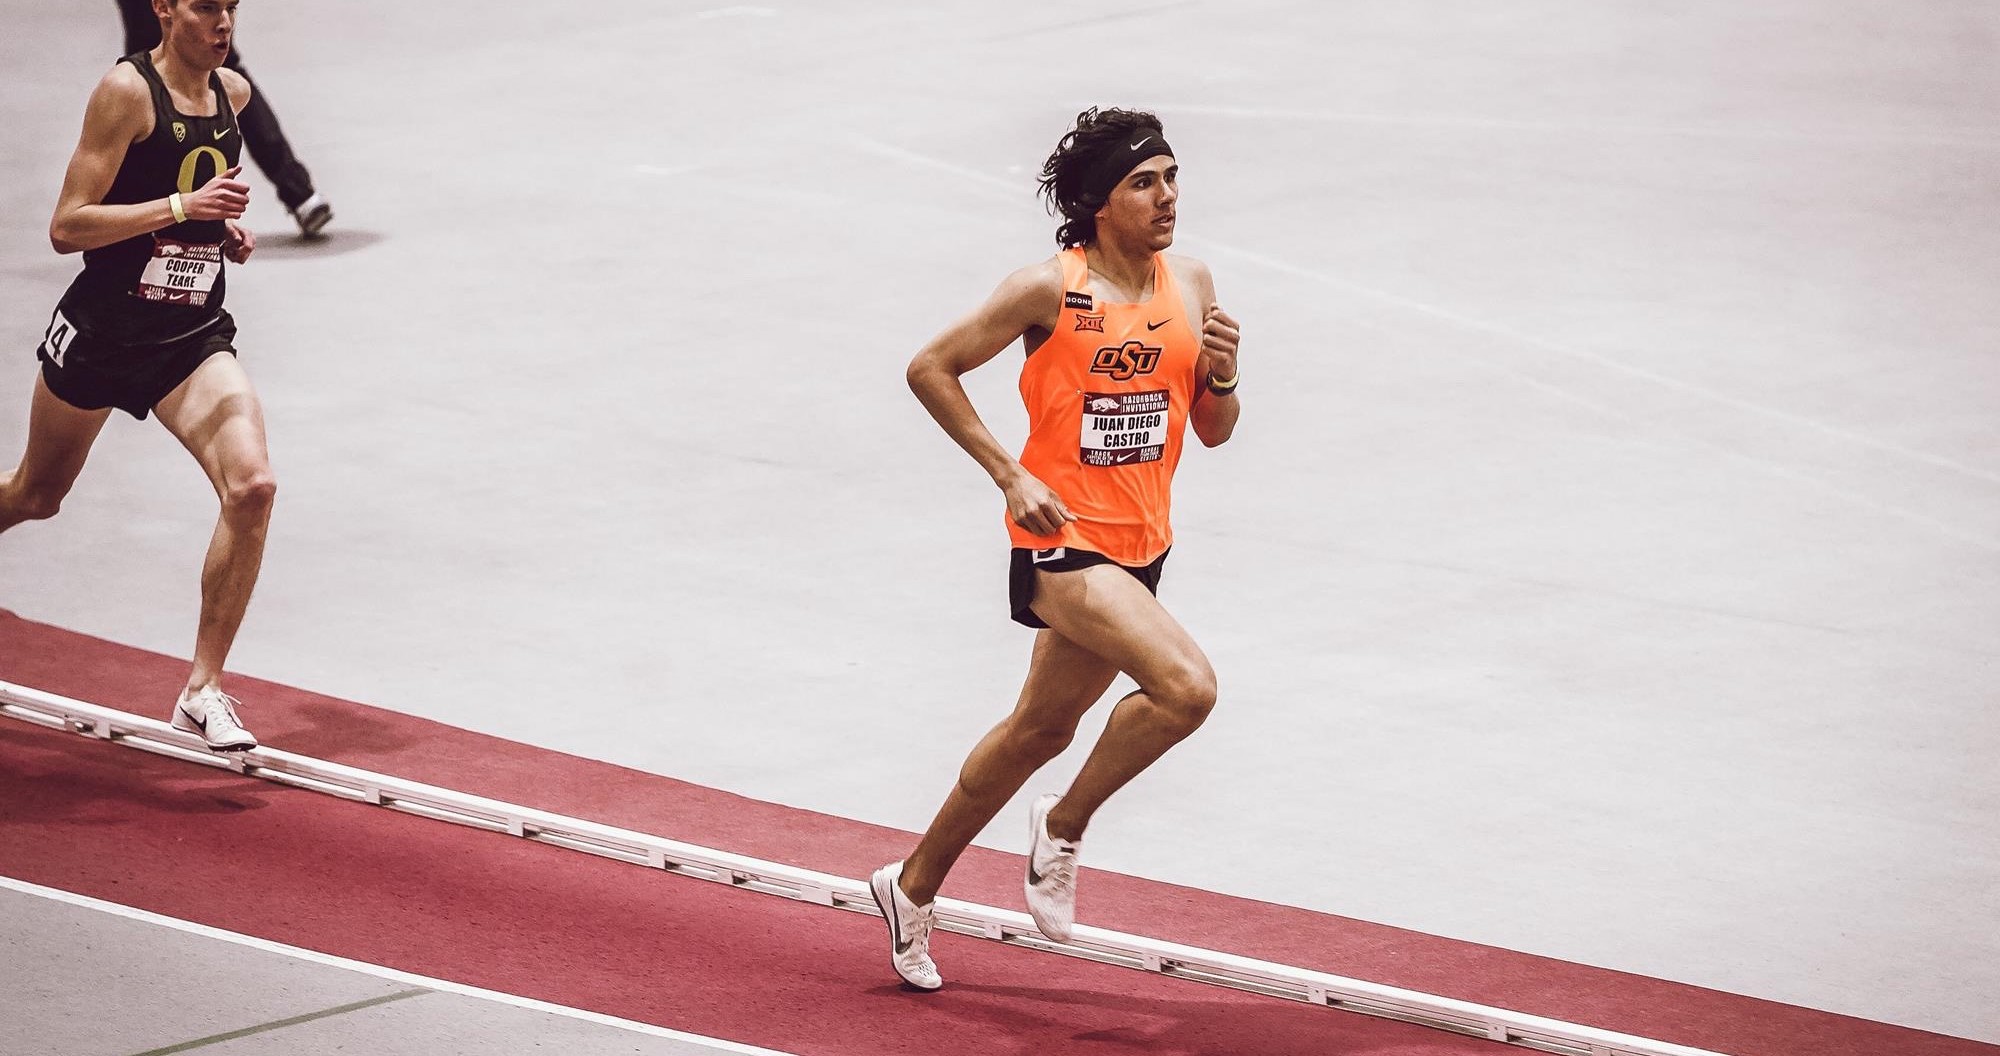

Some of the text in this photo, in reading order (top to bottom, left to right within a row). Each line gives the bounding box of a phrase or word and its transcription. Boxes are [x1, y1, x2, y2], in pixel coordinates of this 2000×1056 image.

[165, 259, 206, 275] COOPER
[166, 273, 197, 288] TEARE
[50, 322, 70, 361] 4
[1089, 340, 1163, 381] OSU
[1122, 392, 1164, 405] RAZORBACK
[1122, 400, 1168, 413] INVITATIONAL
[1092, 414, 1161, 431] JUAN DIEGO
[1103, 431, 1150, 448] CASTRO
